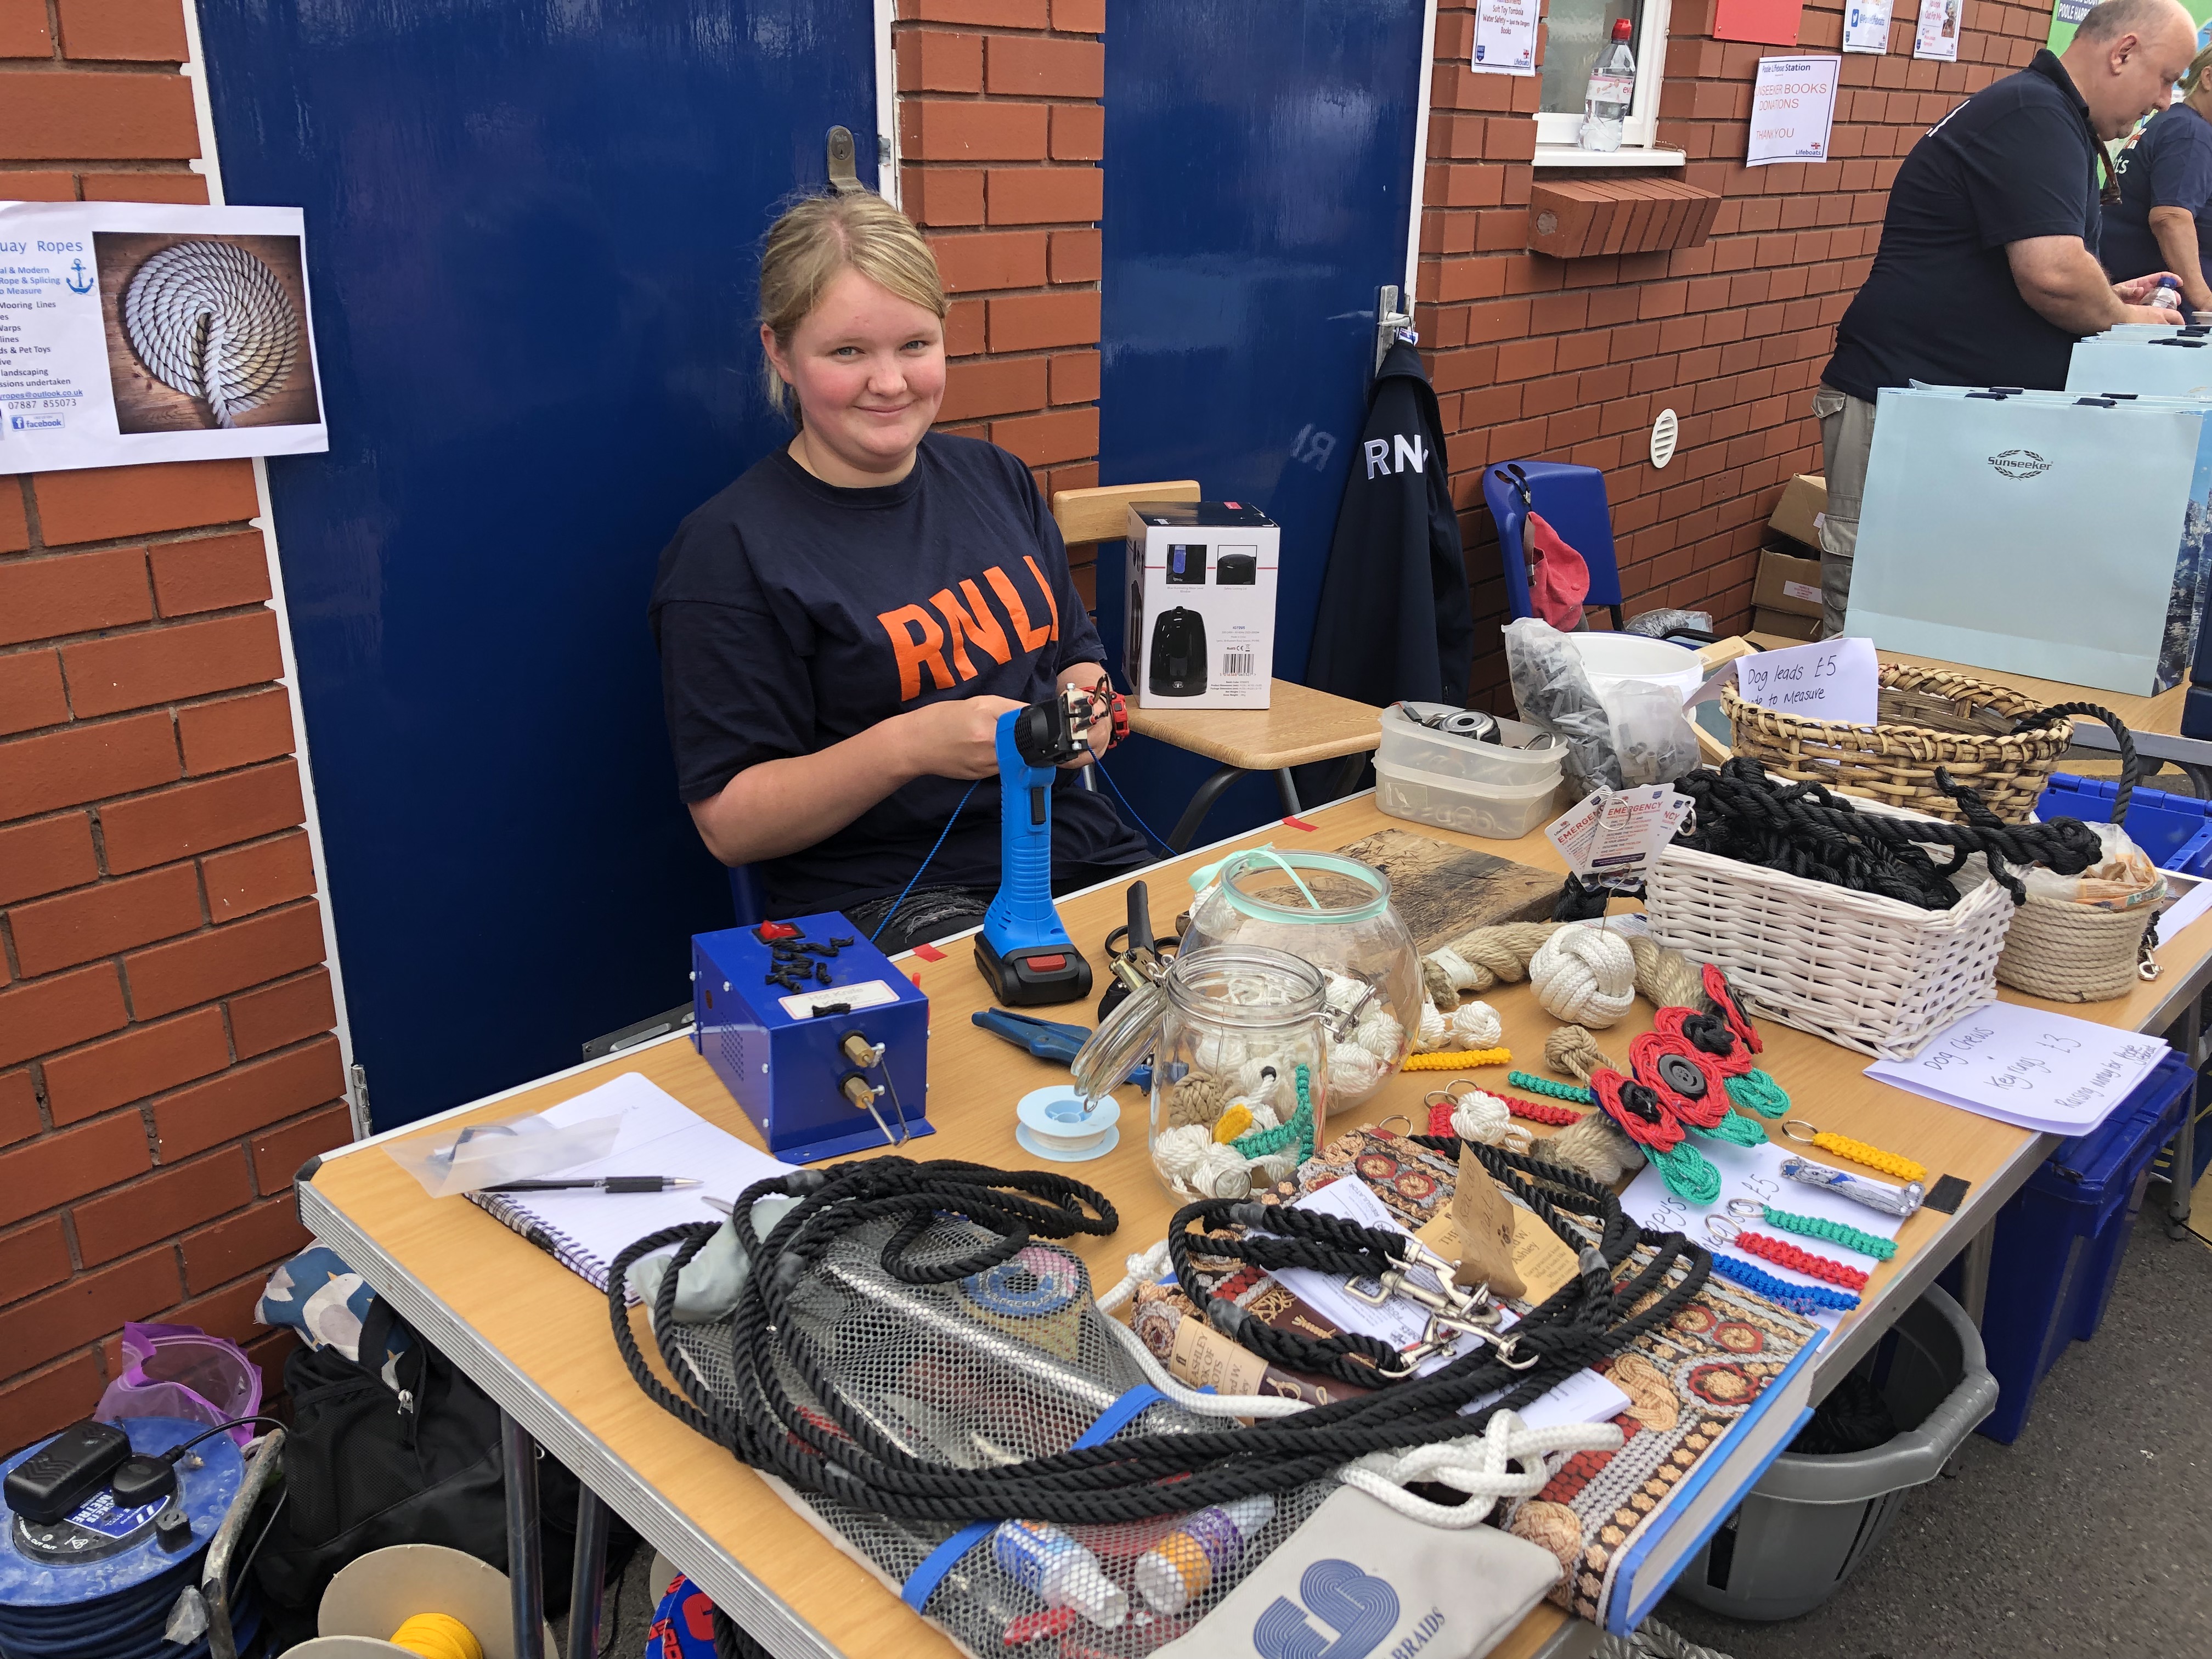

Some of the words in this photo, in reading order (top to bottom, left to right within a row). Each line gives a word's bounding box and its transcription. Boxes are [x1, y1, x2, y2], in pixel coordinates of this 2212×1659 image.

[2058, 3, 2074, 20] POOLE
[1495, 15, 1505, 25] Safety
[1785, 63, 1810, 72] Station
[1784, 83, 1827, 94] BOOKS
[1759, 98, 1799, 111] DONATIONS
[0, 242, 27, 254] uay
[37, 240, 83, 254] Ropes
[30, 276, 60, 285] Splicing
[34, 346, 51, 354] Toys
[26, 378, 71, 386] undertaken
[8, 400, 36, 409] 07887
[43, 398, 77, 408] 855073
[26, 419, 61, 428] facebook
[1364, 434, 1429, 480] RN
[1987, 456, 2052, 471] Sunseeker
[876, 555, 1059, 702] RNLI
[1748, 669, 1768, 691] Dog
[1774, 664, 1803, 682] leads
[1814, 655, 1837, 678] £5
[1769, 693, 1778, 707] to
[1784, 687, 1825, 704] Measure
[1607, 802, 1663, 816] EMERGENCY
[1554, 823, 1571, 836] Lifeboats
[1558, 803, 1606, 843] EMERGENC
[809, 993, 830, 1001] Hot
[833, 987, 864, 998] Knife
[2053, 1087, 2104, 1108] Raising
[1741, 1173, 1779, 1201] £5
[1348, 1182, 1380, 1217] REGULATOR
[1511, 1242, 1539, 1265] Ashley
[1191, 1331, 1207, 1378] ASHLEY
[1204, 1347, 1215, 1366] OF
[72, 1494, 112, 1523] METRE
[1390, 1606, 1445, 1659] BRAIDS
